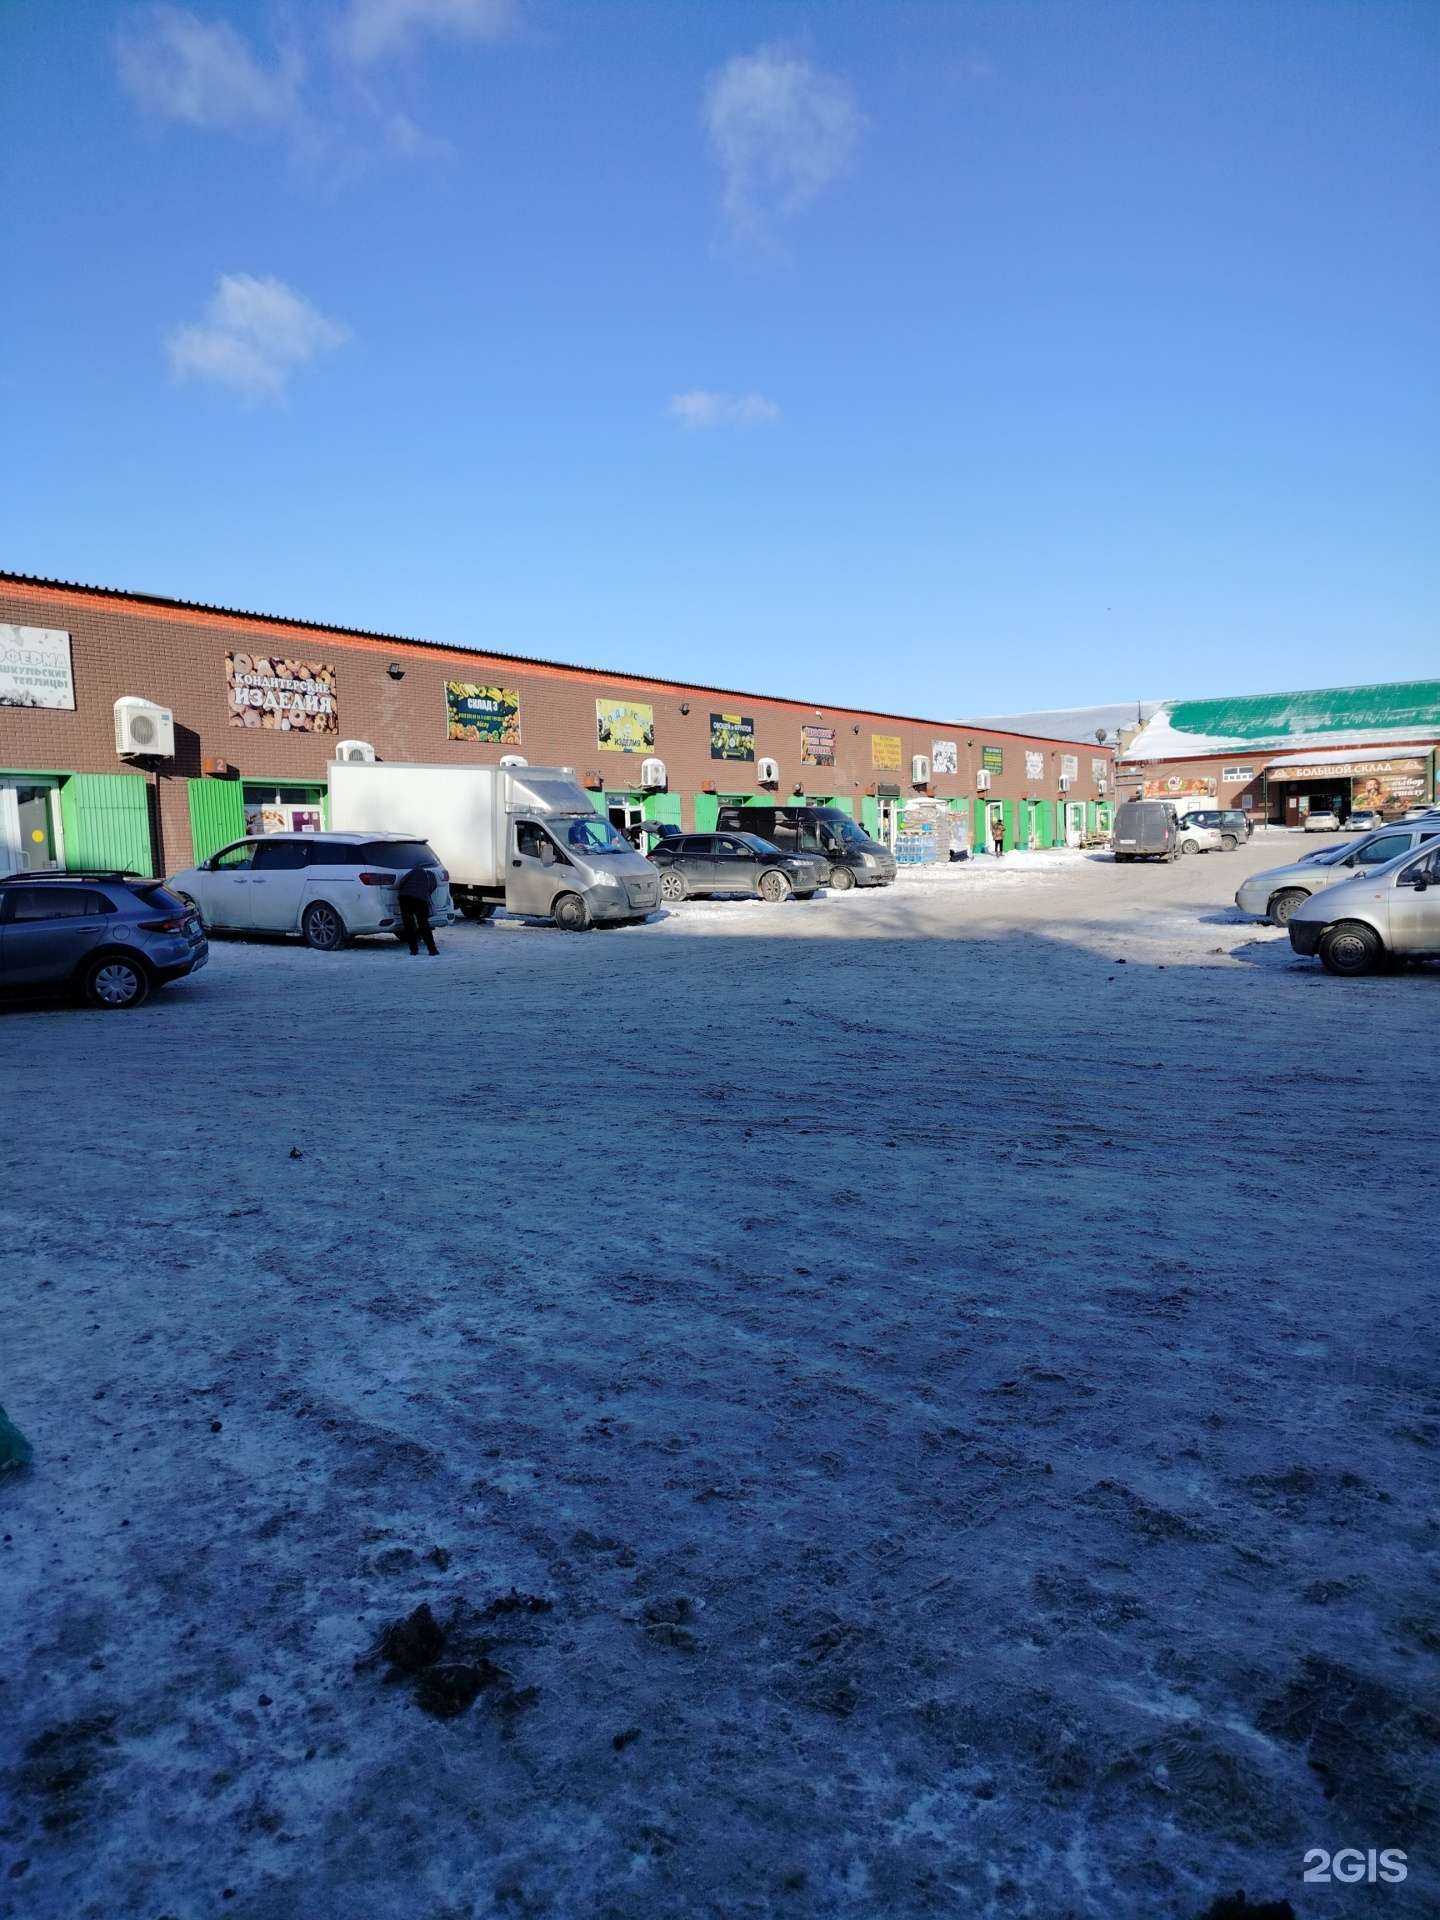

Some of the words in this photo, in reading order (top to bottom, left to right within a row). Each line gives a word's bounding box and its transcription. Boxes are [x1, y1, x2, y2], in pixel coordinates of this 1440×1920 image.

[13, 676, 68, 689] ТЕПЛИЦЫ
[234, 672, 330, 694] КОНДИТЕРСКИЕ
[234, 687, 332, 713] ИЗДЕЛИЯ
[467, 698, 492, 712] СКЛАД
[493, 701, 498, 711] 3
[216, 759, 225, 771] 2
[1296, 763, 1352, 777] БОЛЬШОЙ
[1353, 762, 1393, 773] СКЛАД
